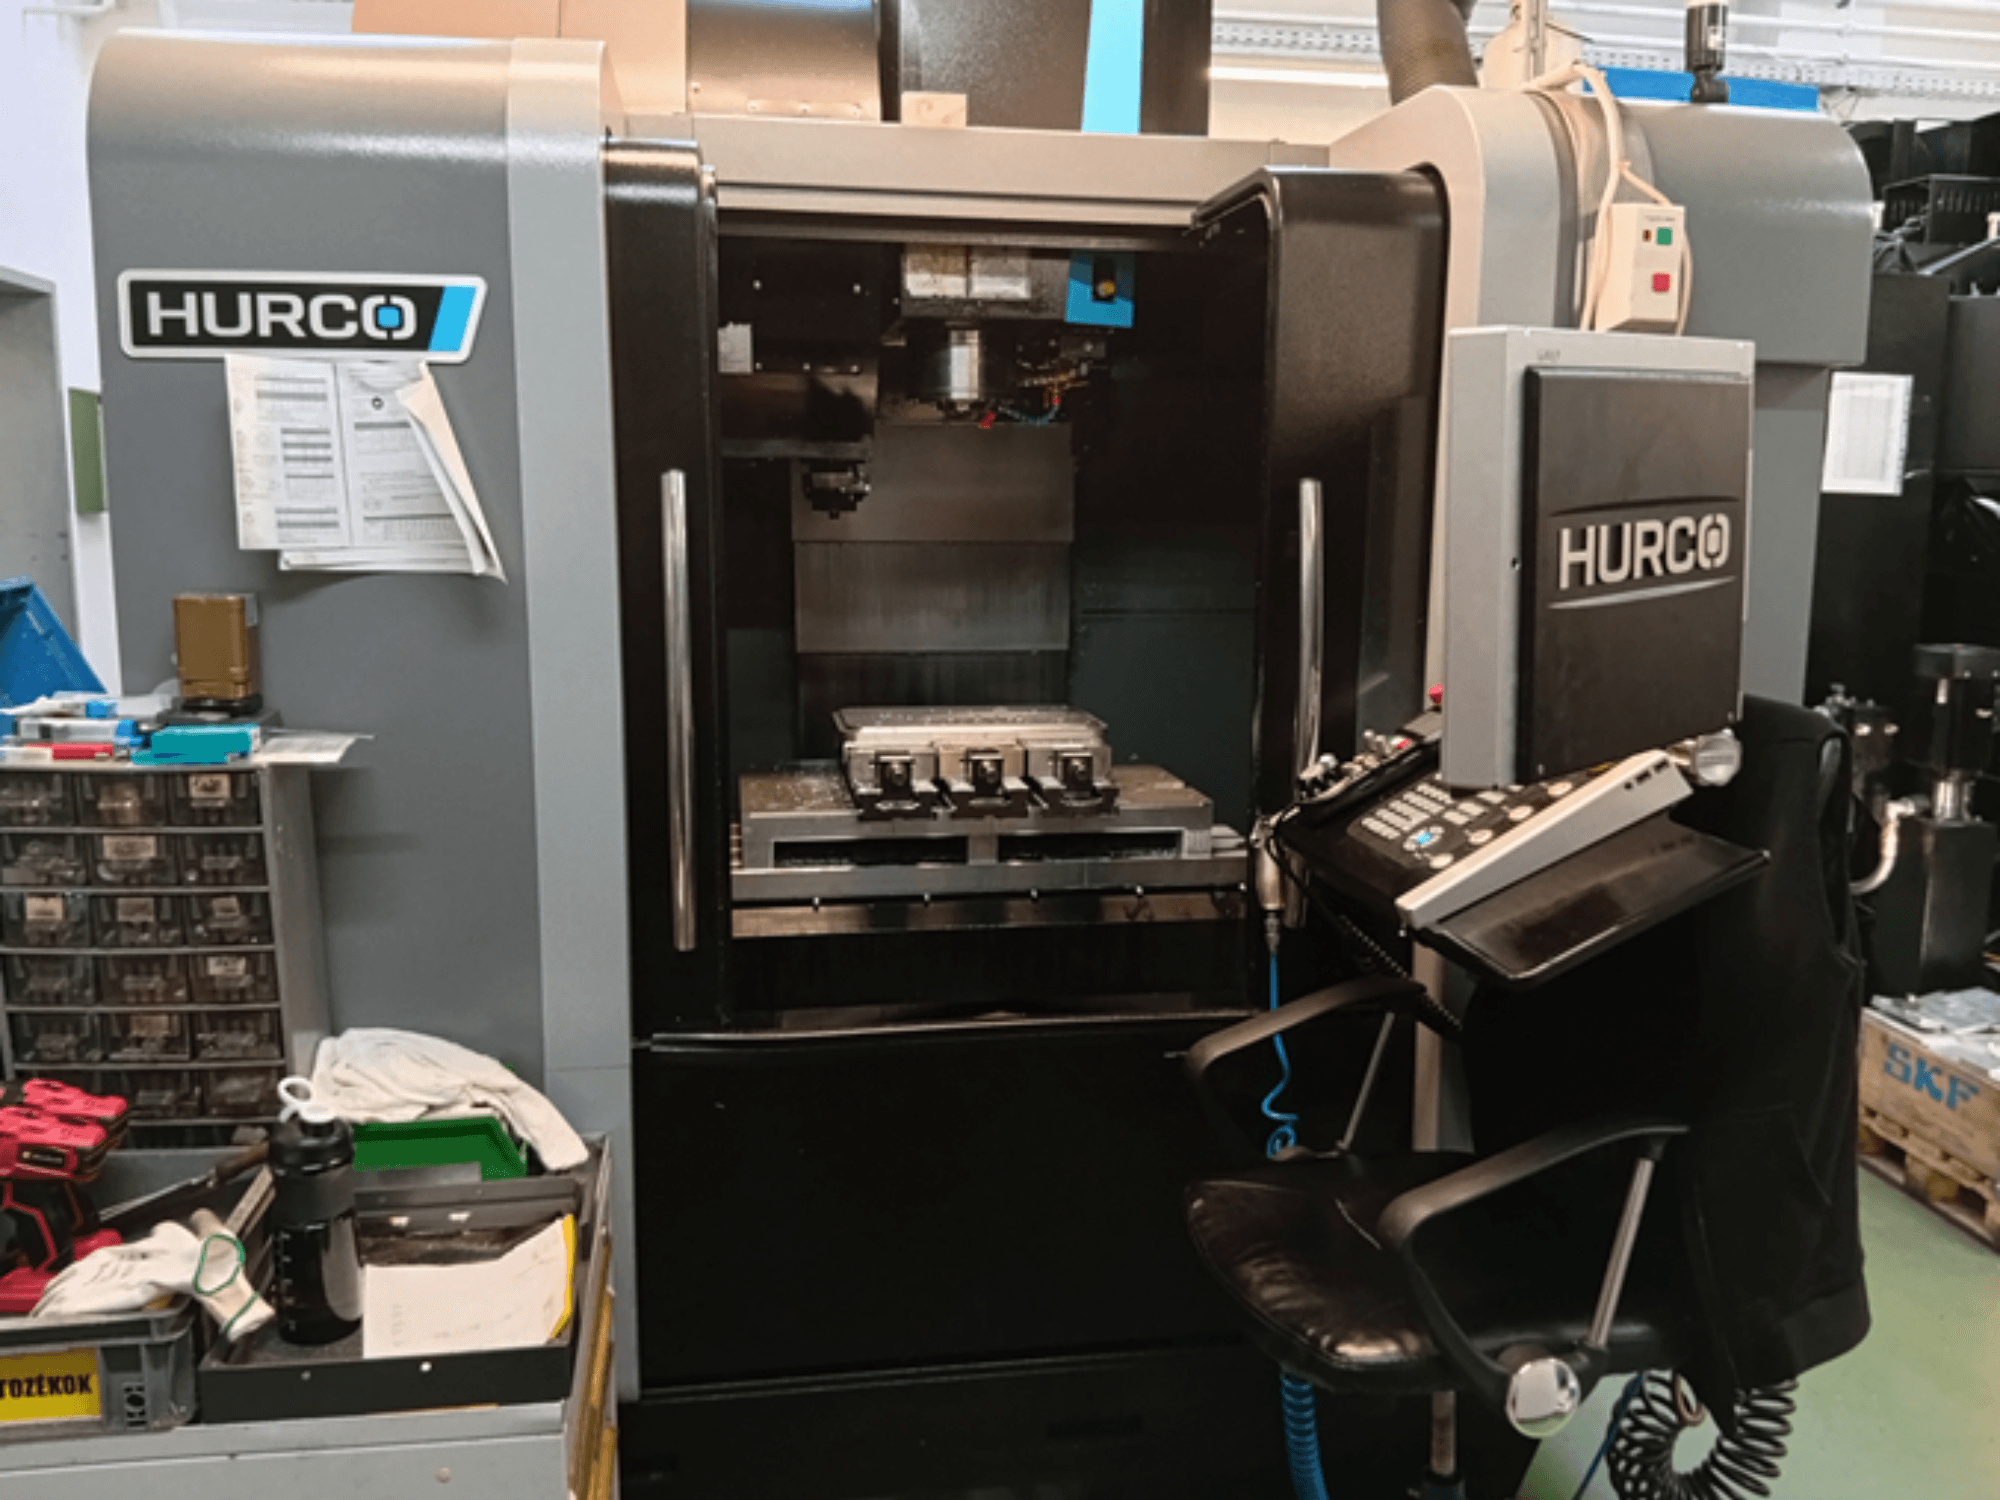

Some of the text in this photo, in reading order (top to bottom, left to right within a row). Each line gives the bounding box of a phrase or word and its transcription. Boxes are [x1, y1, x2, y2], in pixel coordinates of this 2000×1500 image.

[147, 292, 416, 340] HURCO
[1559, 513, 1730, 589] HURCO
[1885, 1043, 1979, 1109] SKF
